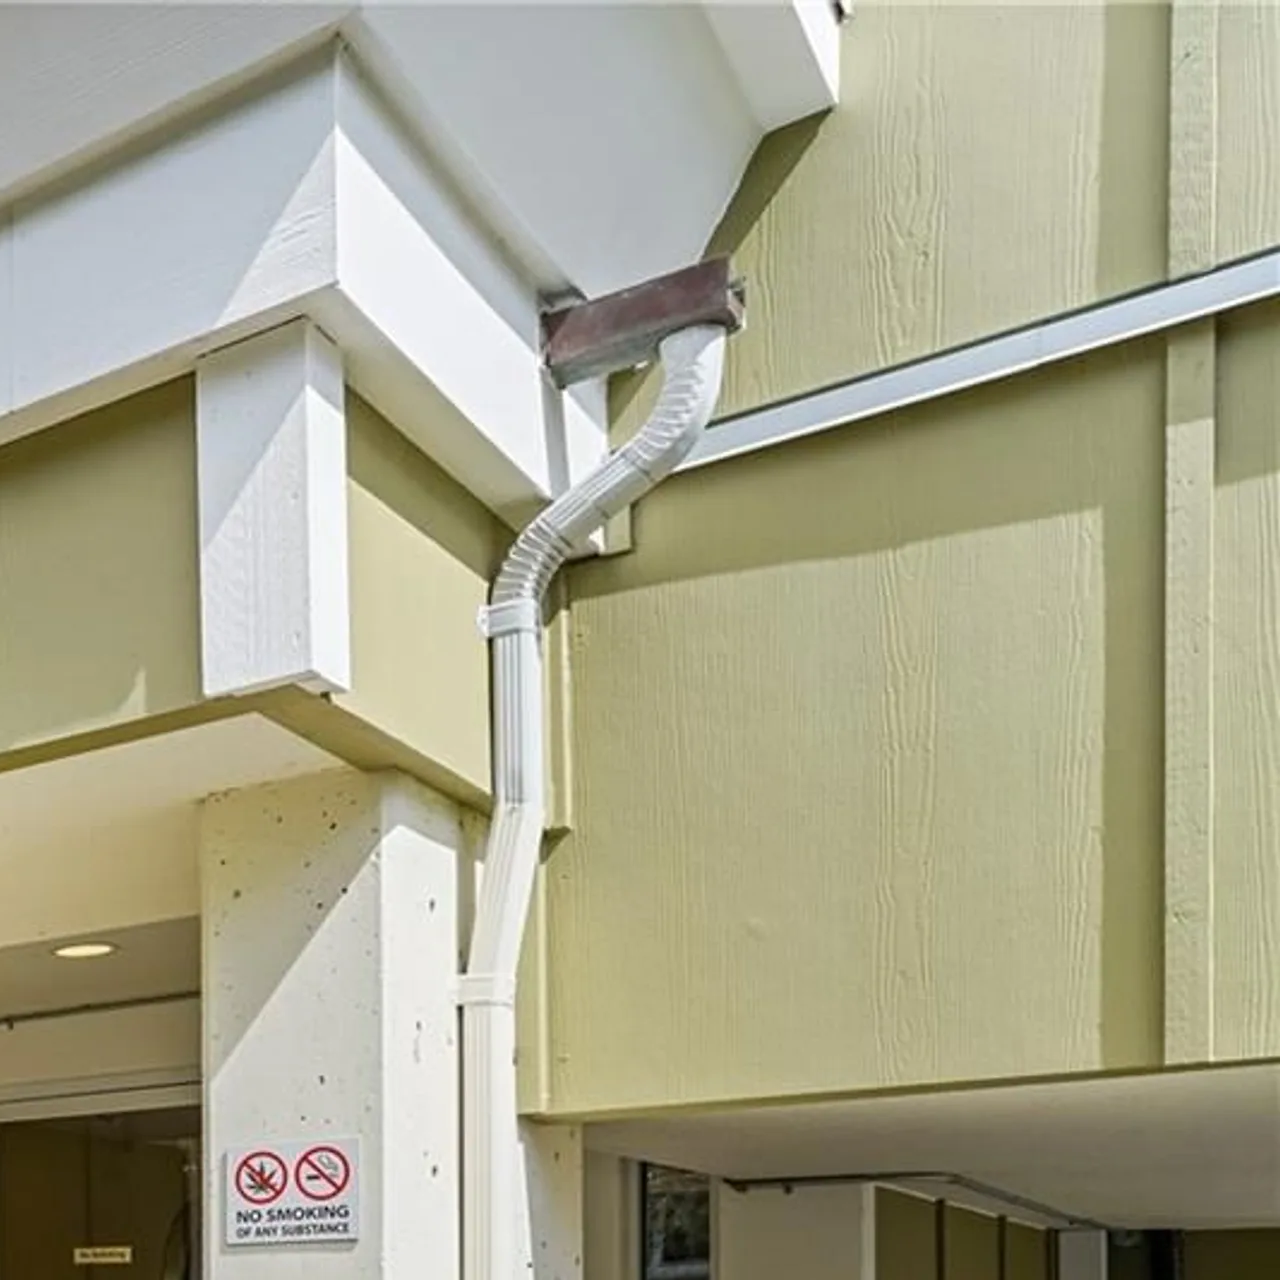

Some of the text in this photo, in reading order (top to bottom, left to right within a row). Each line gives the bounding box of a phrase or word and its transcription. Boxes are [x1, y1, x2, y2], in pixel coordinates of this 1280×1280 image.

[236, 1204, 350, 1224] NO SMOKING
[236, 1221, 349, 1239] OF ANY SUBSTANCE
